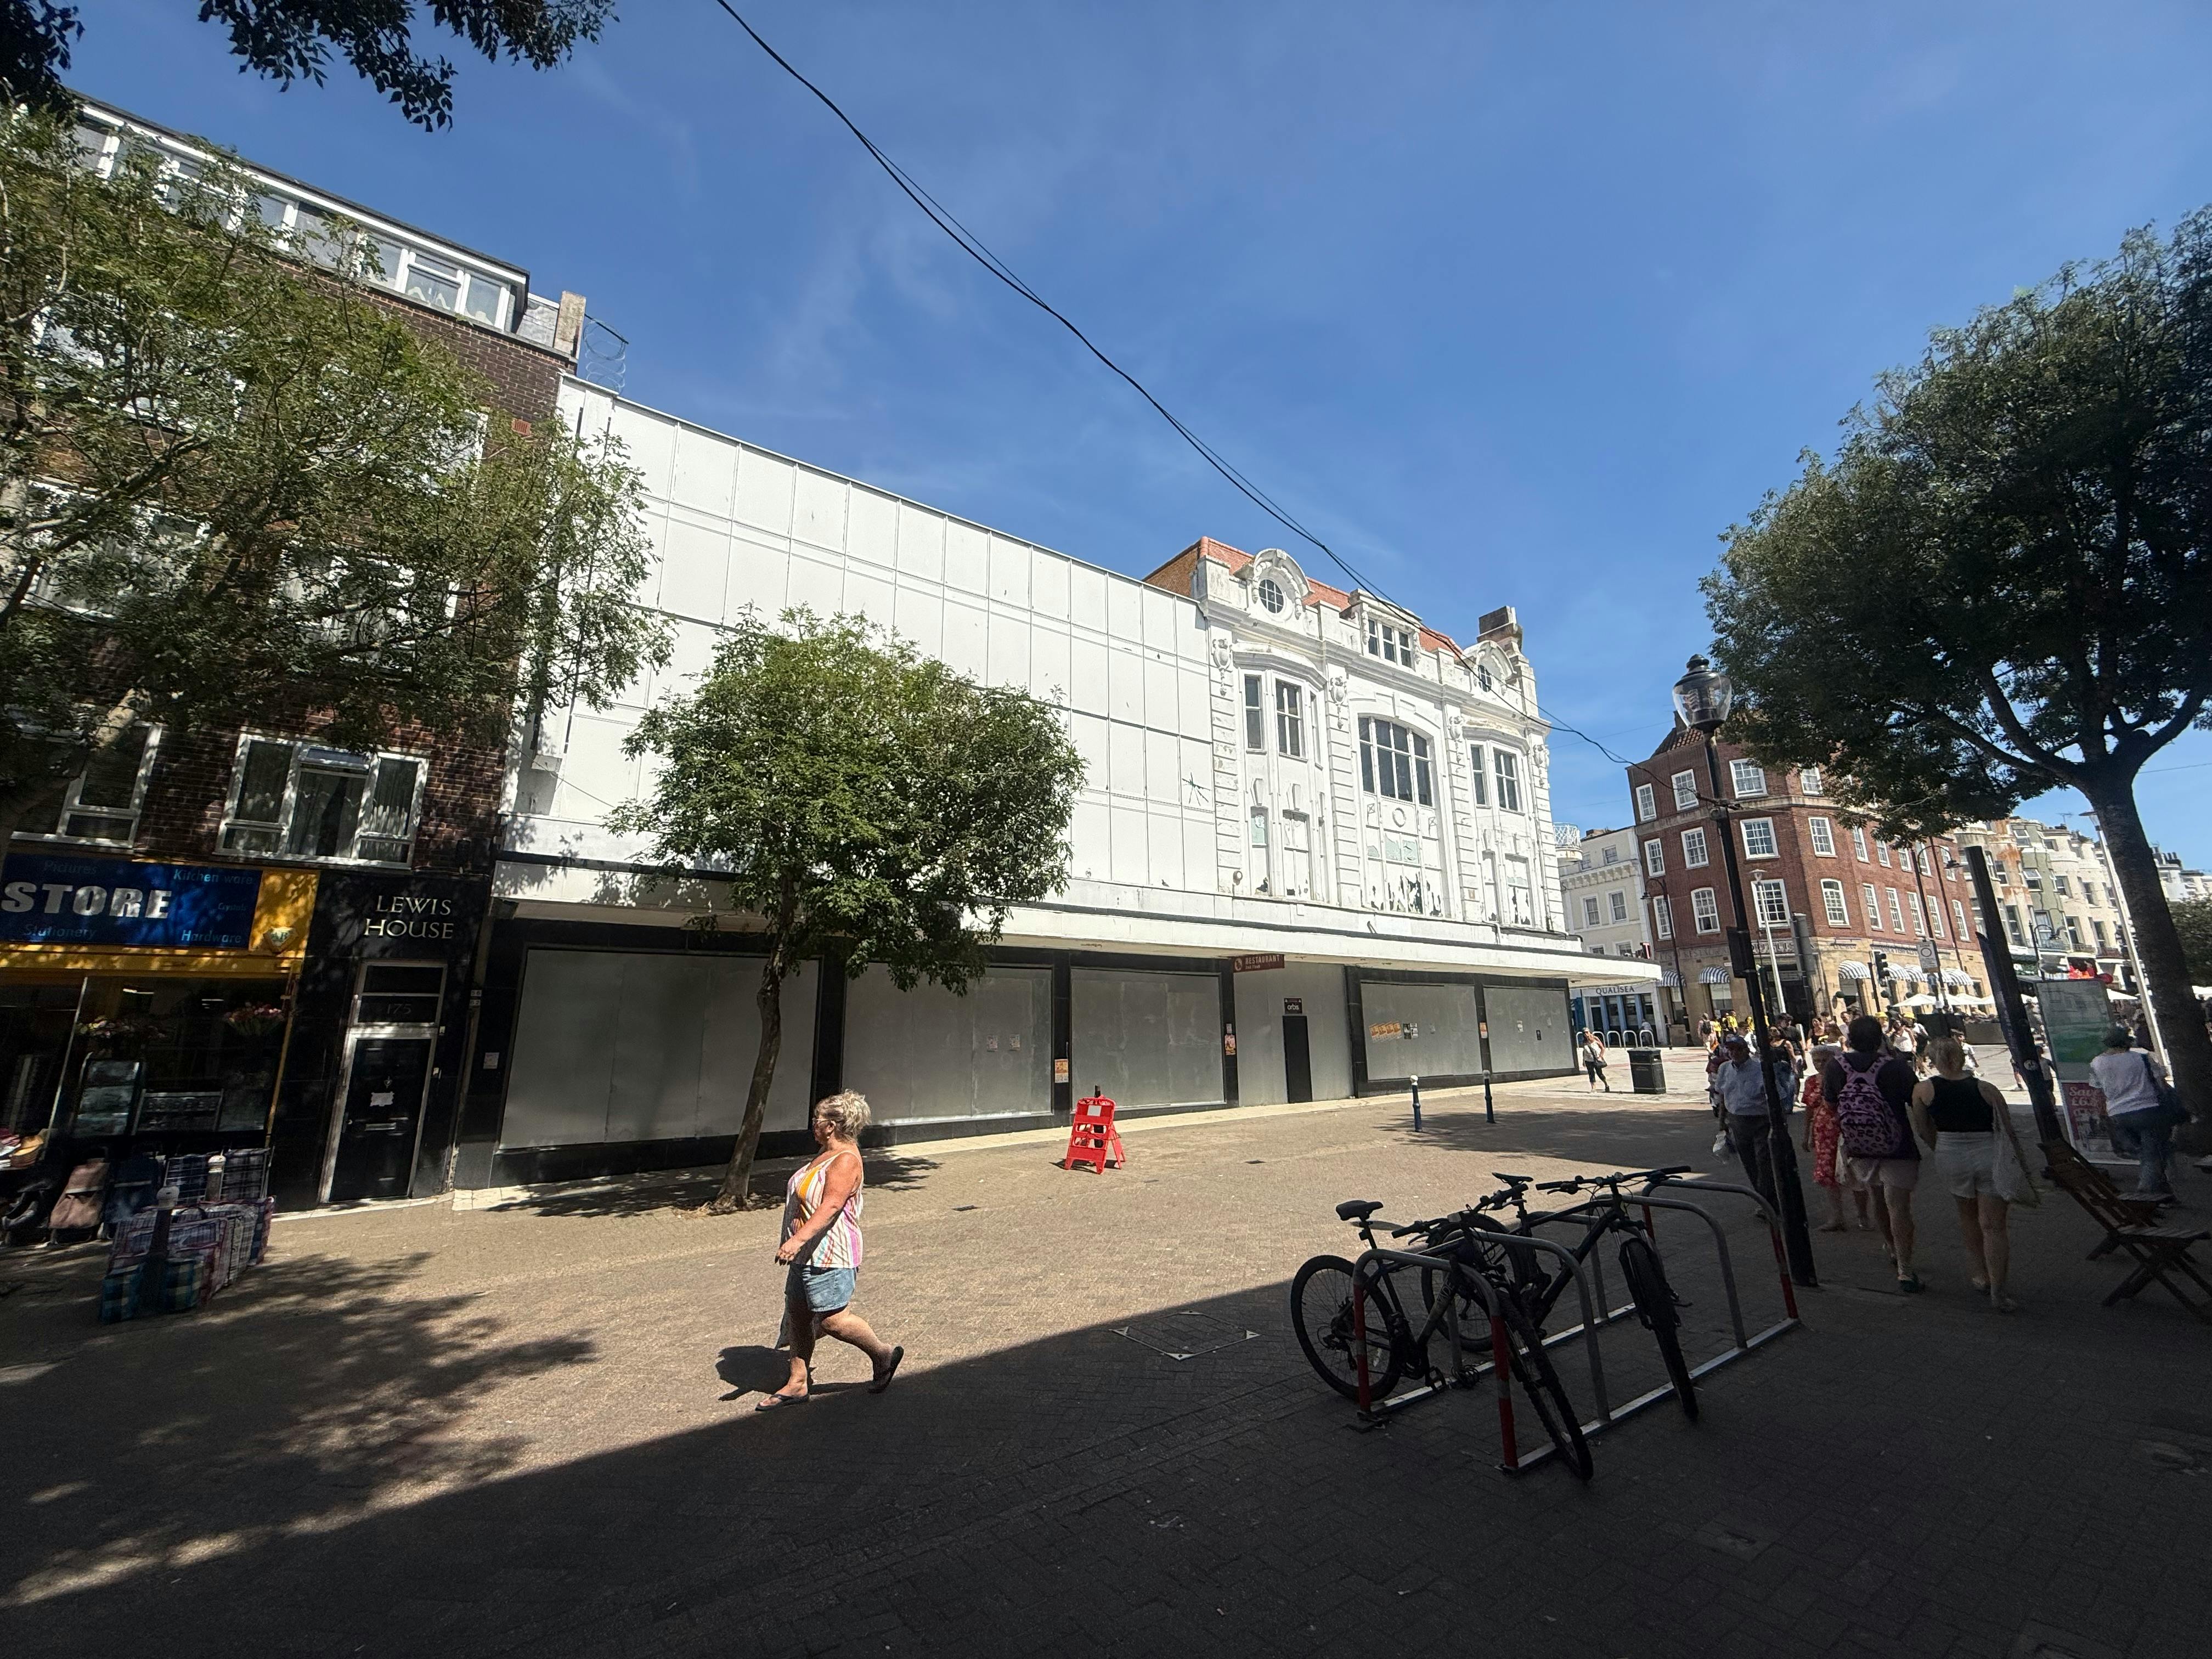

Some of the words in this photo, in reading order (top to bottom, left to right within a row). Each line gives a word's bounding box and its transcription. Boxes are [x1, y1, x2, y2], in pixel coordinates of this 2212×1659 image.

[44, 860, 98, 875] Pictures
[172, 868, 219, 883] Kitchen
[224, 874, 254, 885] ware
[1, 881, 173, 919] STORE
[375, 895, 452, 916] LEWIS
[24, 924, 97, 940] Stationery
[363, 918, 454, 939] HOUSE
[182, 929, 242, 945] Hardware
[1245, 954, 1280, 964] RESTAURANT
[1596, 986, 1635, 996] QUALISEA
[387, 1002, 413, 1015] 175
